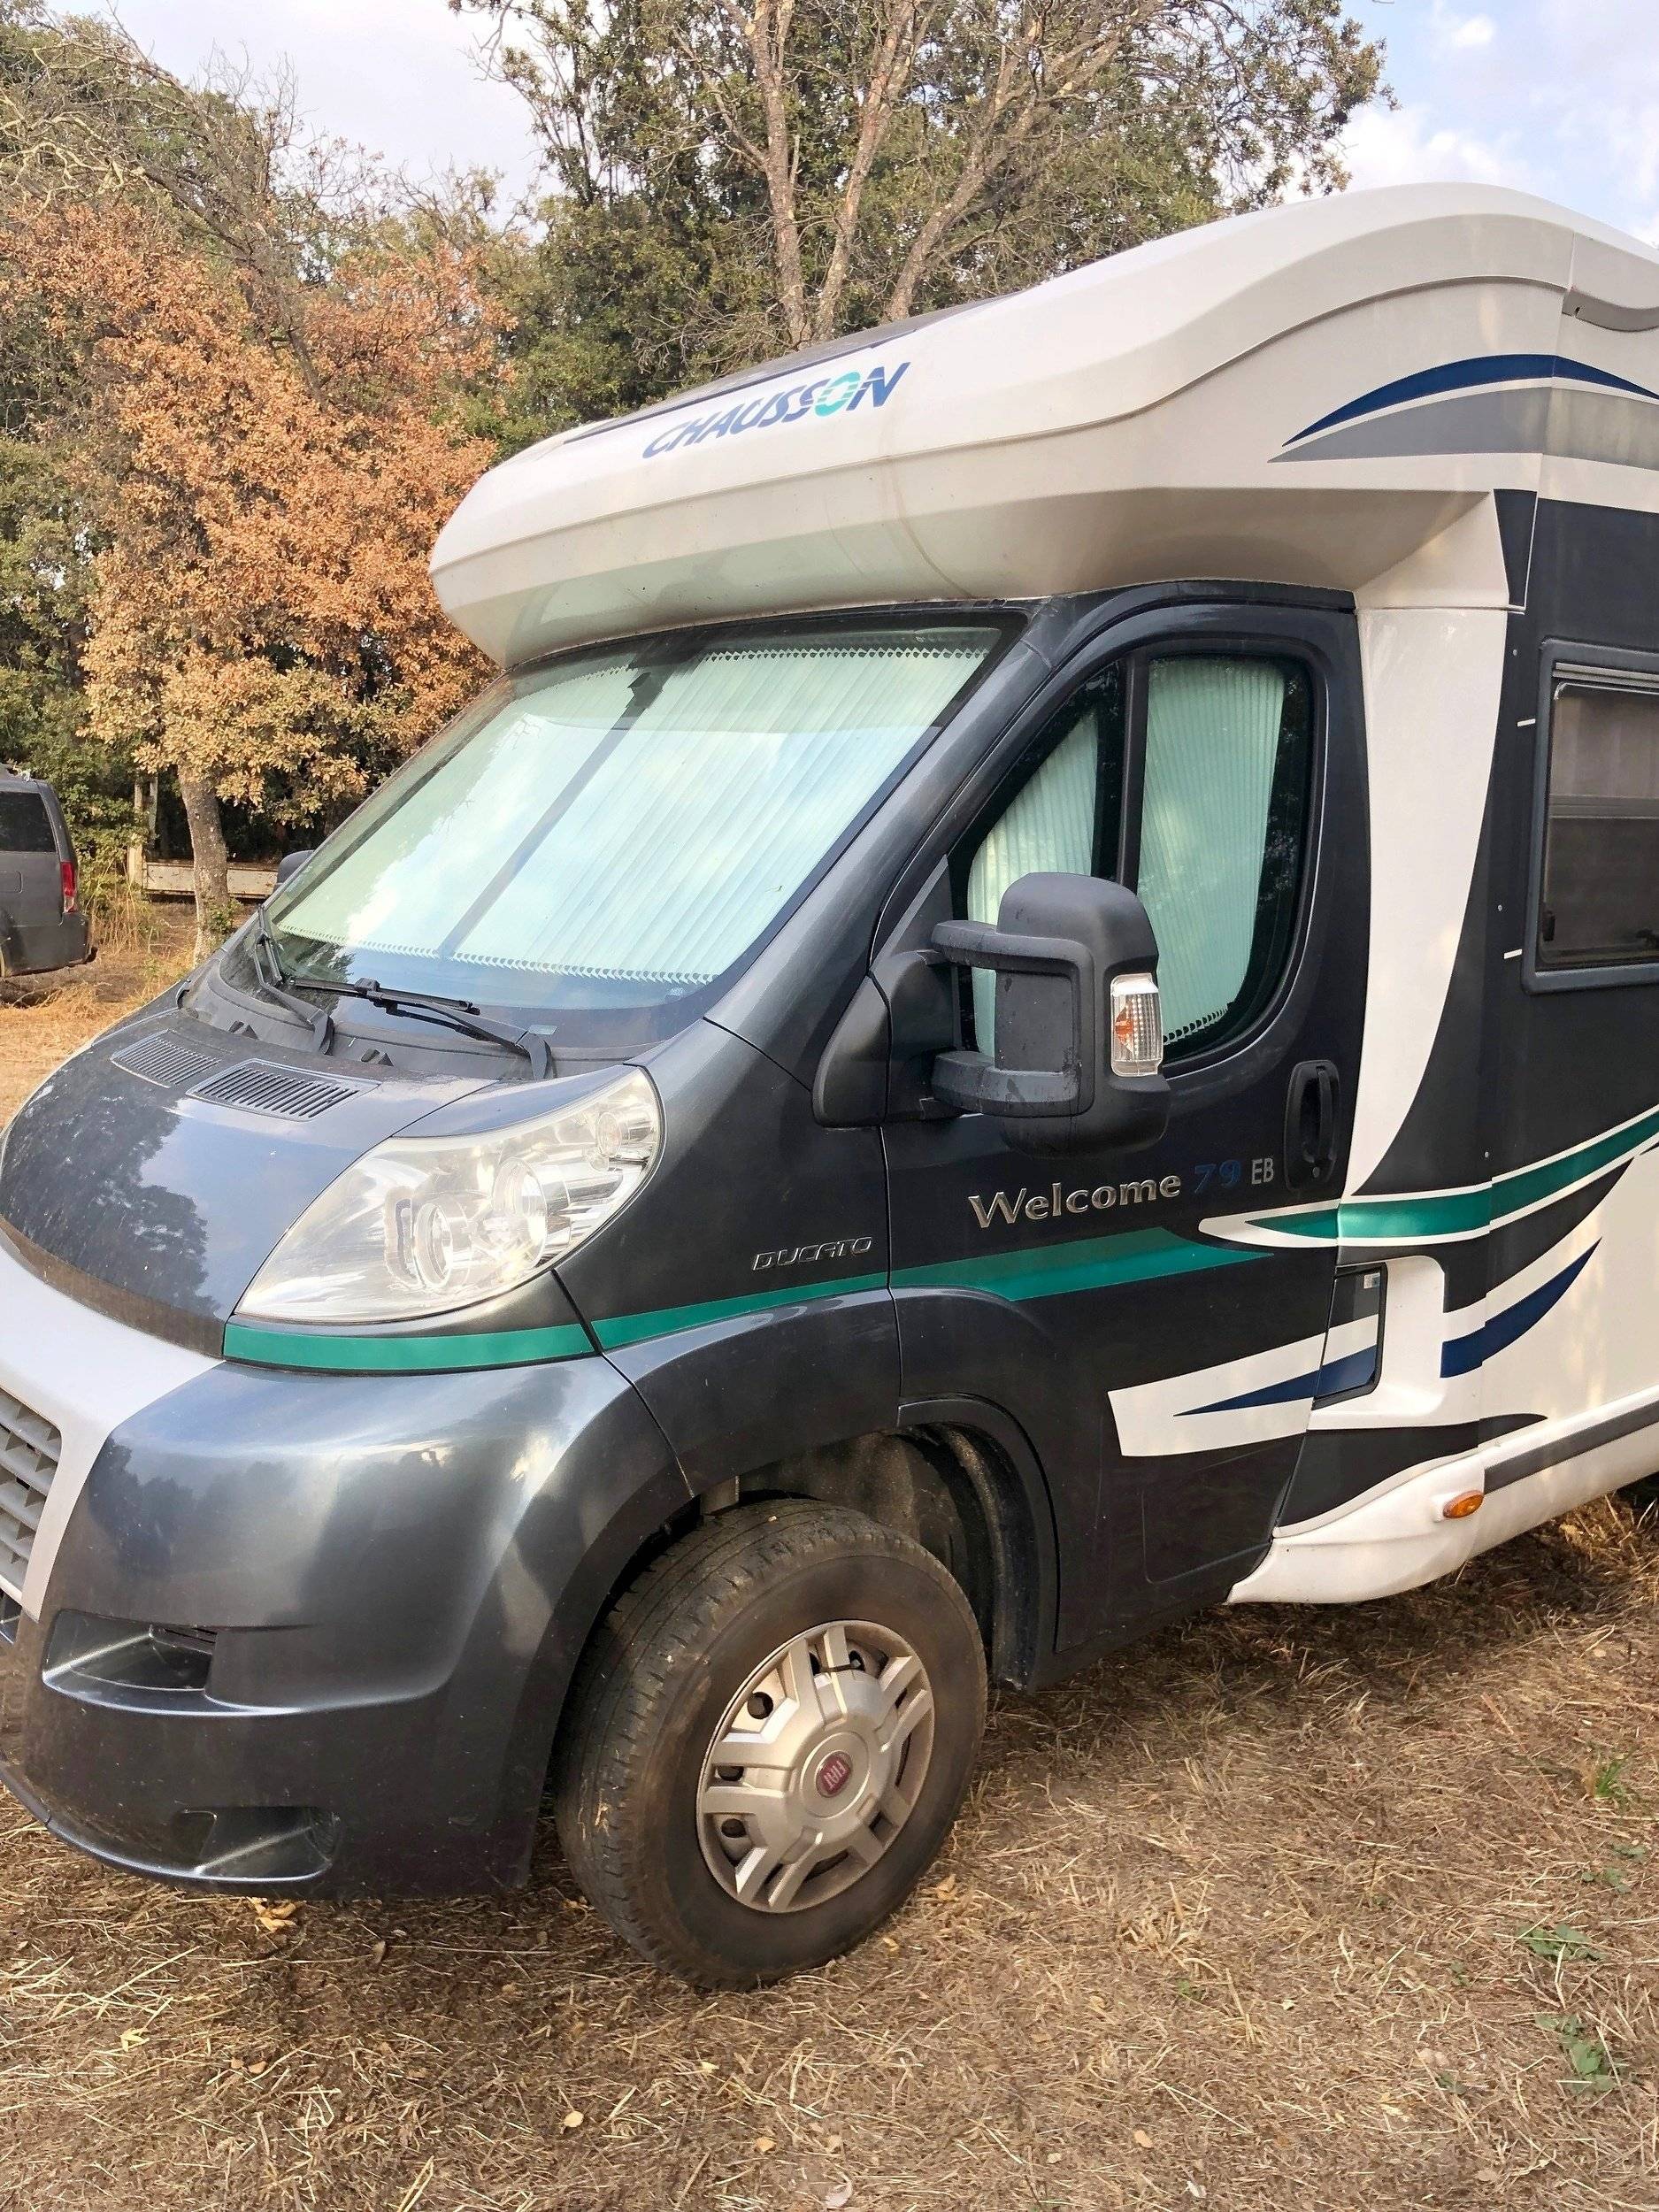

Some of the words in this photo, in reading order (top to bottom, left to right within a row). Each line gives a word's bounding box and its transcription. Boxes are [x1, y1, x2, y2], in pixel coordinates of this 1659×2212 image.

[642, 361, 911, 458] CHAUSSON
[968, 1174, 1181, 1228] Welcome
[1194, 1160, 1242, 1194] 79
[1251, 1158, 1275, 1185] EB
[752, 1236, 873, 1271] DUCATO
[823, 1760, 848, 1790] FIAT
